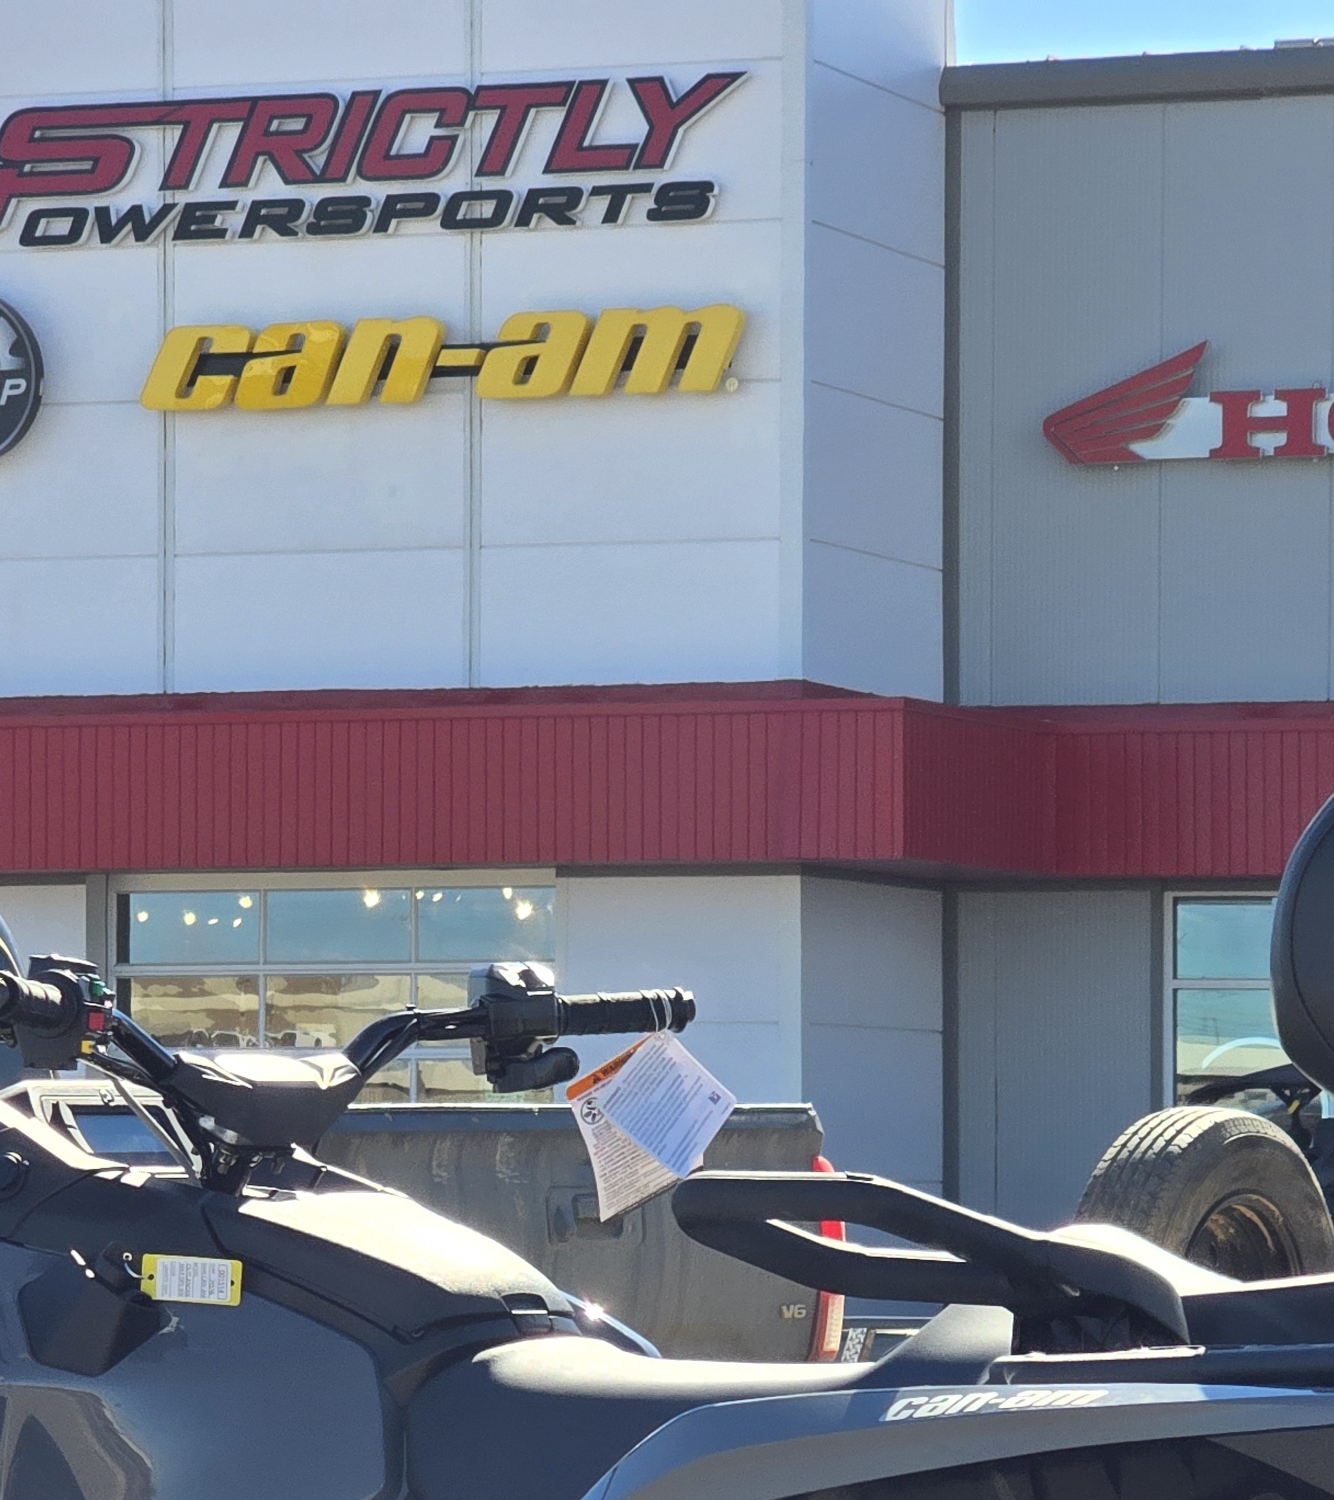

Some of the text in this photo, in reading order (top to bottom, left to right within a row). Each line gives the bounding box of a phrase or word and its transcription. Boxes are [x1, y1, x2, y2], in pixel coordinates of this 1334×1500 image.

[140, 304, 745, 411] can-am
[780, 1303, 807, 1319] V6
[883, 1389, 1110, 1422] can-am
